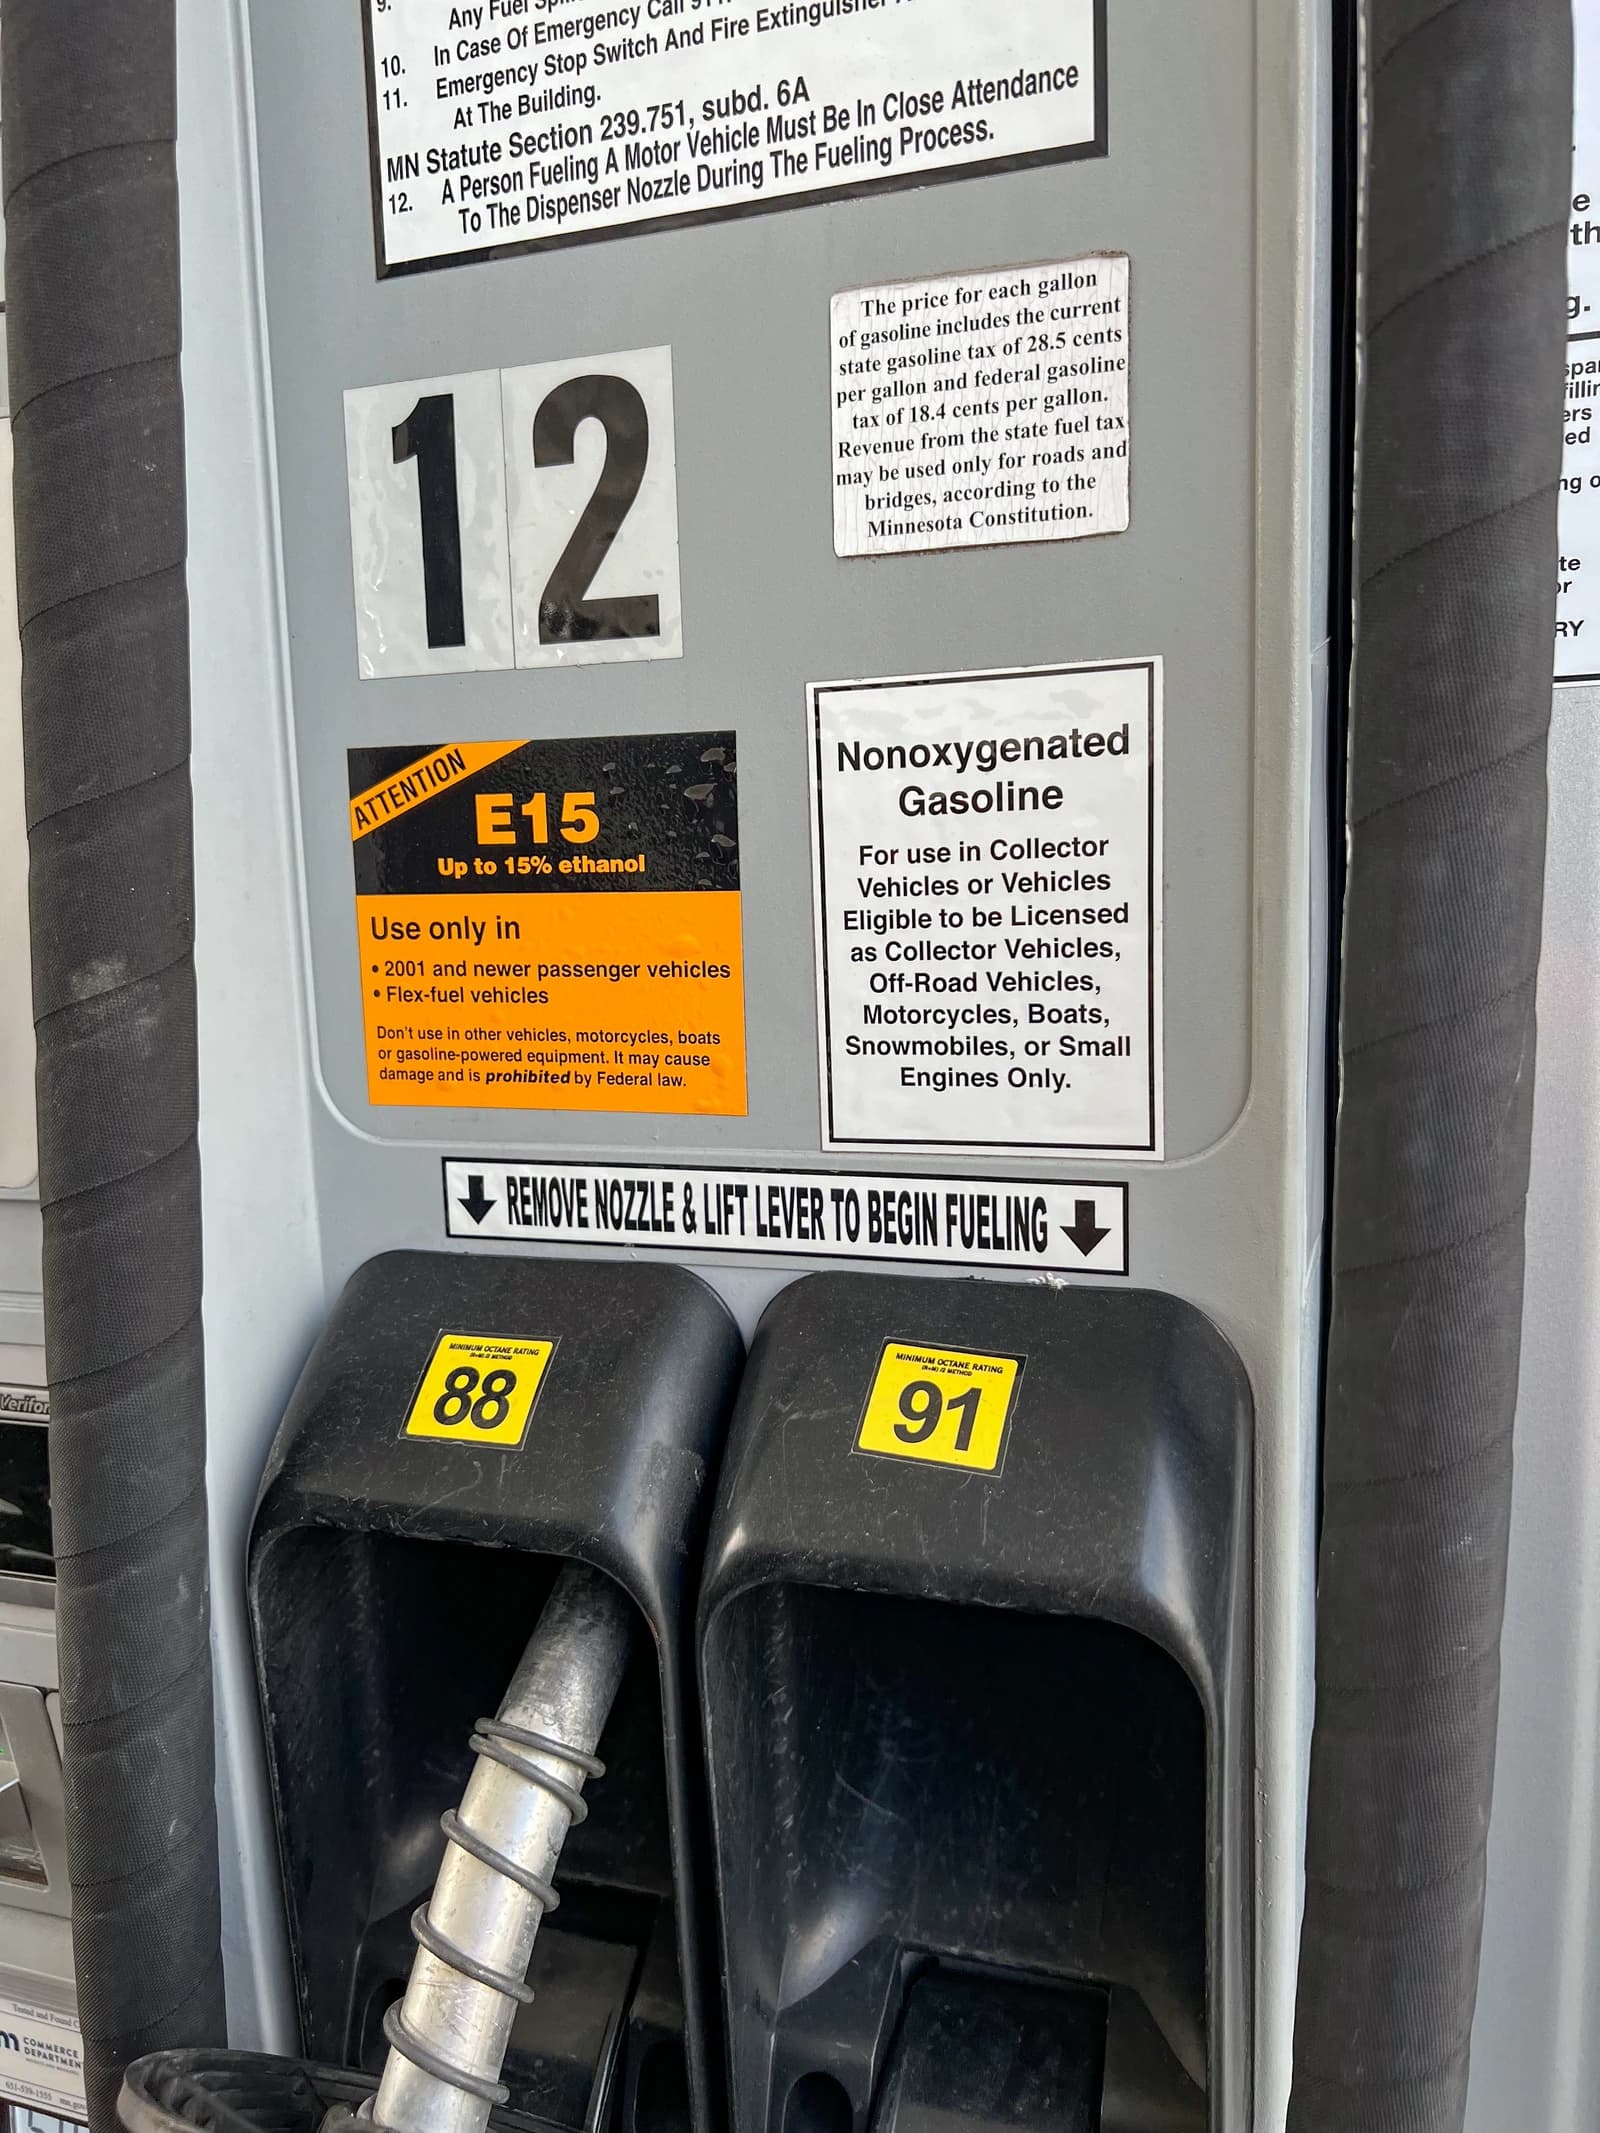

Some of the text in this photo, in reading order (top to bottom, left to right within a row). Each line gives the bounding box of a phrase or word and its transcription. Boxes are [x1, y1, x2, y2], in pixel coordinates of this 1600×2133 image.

[454, 84, 601, 129] At The Building.
[387, 76, 810, 183] MN Statute Section 239.751, subd. 6A
[389, 65, 1078, 215] 12. A Person Fueling A Motor Vehicle Must Be In Close Attendance
[458, 119, 994, 234] To The Dispenser Nozzle During The Fueling Process.
[861, 272, 1096, 317] The price for each gallon
[839, 297, 1120, 350] of gasoline includes the current
[840, 327, 1122, 376] state gasoline tax of 28.5 cents
[837, 356, 1125, 408] per gallon and federal gasoline
[853, 388, 1108, 429] tax of 18.4 cents per gallon.
[839, 415, 1125, 458] Revenue from the state fuel tax
[865, 473, 1096, 511] bridges, according to the
[392, 374, 660, 649] 12
[868, 503, 1093, 537] Minnesota Constitution.
[838, 723, 1129, 774] Nonoxygenated
[354, 748, 467, 830] ATTENTION
[899, 781, 1063, 817] Gasoline
[474, 791, 600, 845] E15
[438, 854, 645, 879] Up to 15% ethanol
[860, 837, 1109, 866] For use in Collector
[857, 870, 1111, 898] Vehicles or Vehicles
[371, 915, 520, 946] Use only in
[844, 902, 1128, 935] Eligible to be Licensed
[851, 937, 1120, 962] as Collector Vehicles,
[385, 960, 730, 982] 2001 and newer passenger vehicles
[870, 970, 1100, 995] Off-Road Vehicles,
[387, 986, 549, 1004] Flex-fuel vehicles
[864, 1003, 1109, 1029] Motorcycles, Boats,
[377, 1025, 720, 1047] Don't use in other vehicles, motorcycles, boats
[846, 1035, 1130, 1060] Snowmobiles, or Small
[378, 1047, 710, 1069] or gasoline-powered equipment. It may cause
[379, 1067, 686, 1088] damage and is prohibited by Federal law.
[901, 1067, 1071, 1094] Engines Only.
[506, 1176, 1048, 1253] REMOVE NOZZLE & LIFT LEVER TO BEGIN FUELING
[449, 1343, 541, 1356] MINIMUM OCTANE RATING
[896, 1353, 935, 1365] MINIMUM
[937, 1359, 970, 1369] OCTANE
[972, 1363, 1003, 1374] RATING
[433, 1366, 517, 1429] 88
[894, 1380, 982, 1451] 91
[23, 2037, 79, 2058] COMMERCE
